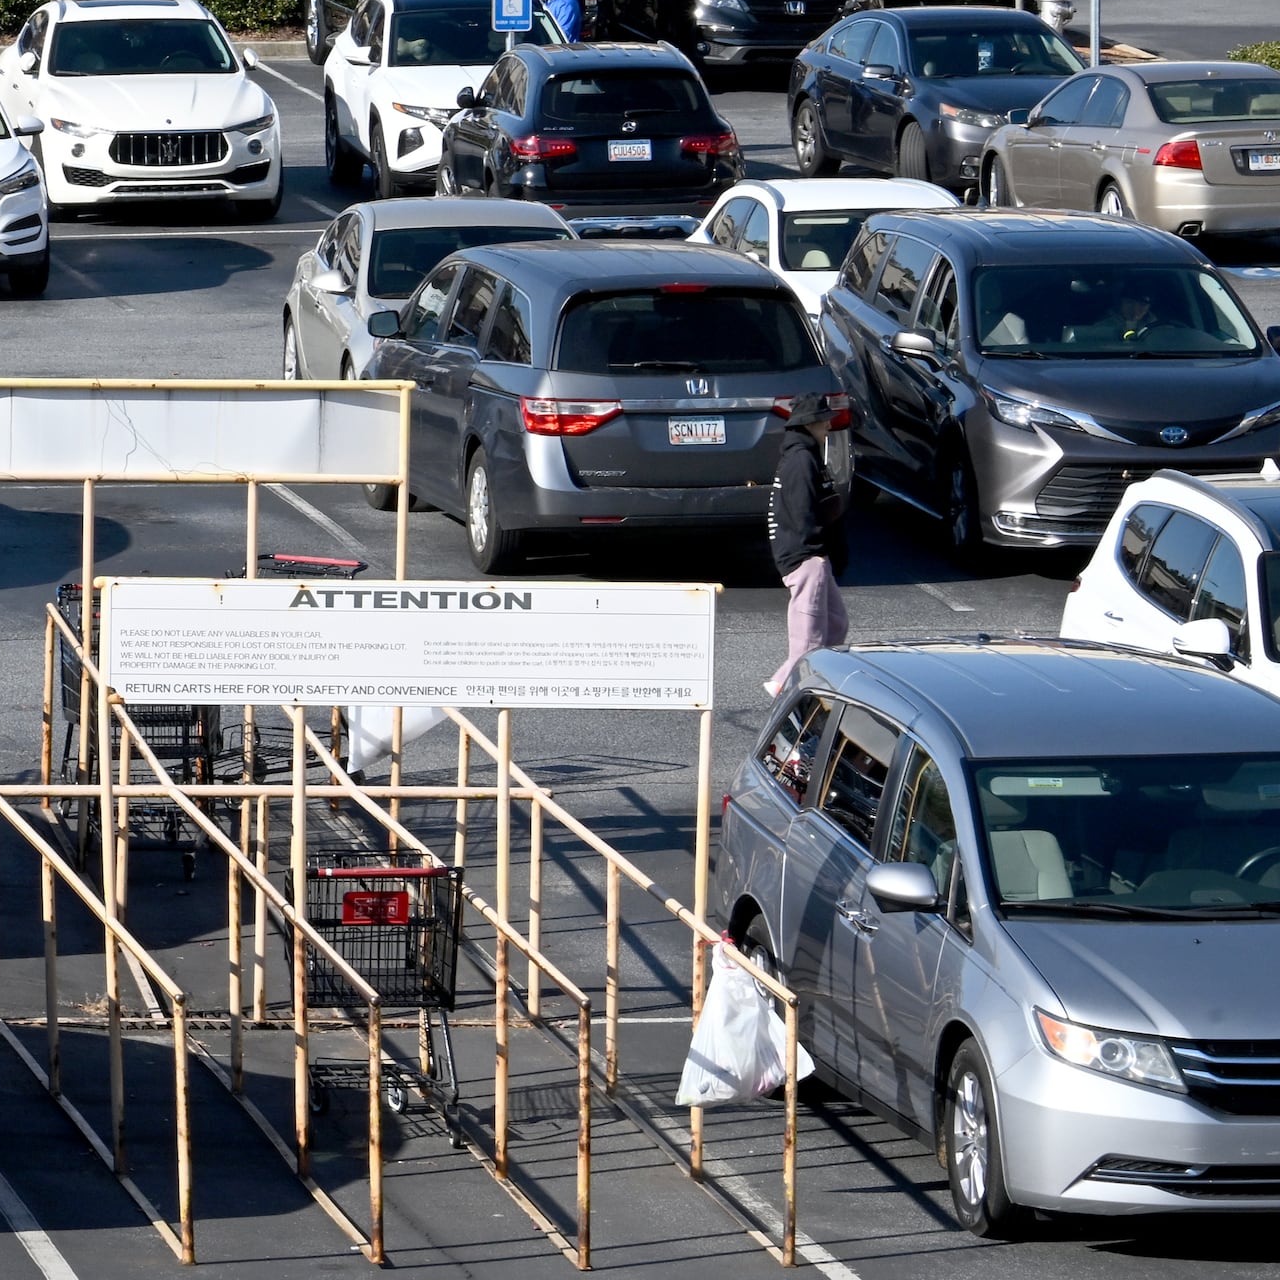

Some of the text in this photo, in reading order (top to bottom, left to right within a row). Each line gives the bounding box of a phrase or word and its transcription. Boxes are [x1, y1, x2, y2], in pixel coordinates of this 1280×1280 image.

[674, 423, 718, 438] SCN1177
[289, 589, 532, 611] ATTENTION
[120, 629, 321, 639] PLEASE DO NOT LEAVE ANY VALUABLES IN YOUR CAR.
[120, 640, 406, 651] WE ARE NOT RESPONSIBLE FOR LOST OR STOLEN ITEM IN THE PARKING LOT.
[120, 652, 339, 662] WE WILL NOT BE HELD LIABLE FOR ANY BODILY INJURY OR
[120, 661, 161, 669] PROPERTY
[162, 662, 196, 670] DAMAGE
[198, 662, 206, 670] IN
[207, 662, 222, 670] THE
[224, 663, 258, 671] PARKING
[126, 682, 457, 696] RETURN CARTS HERE FOR YOUR SAFETY AND CONVENIENCE
[466, 685, 691, 698] 안전과 편의를 위해 이곳에 쇼핑카트를 반환해 주세요
